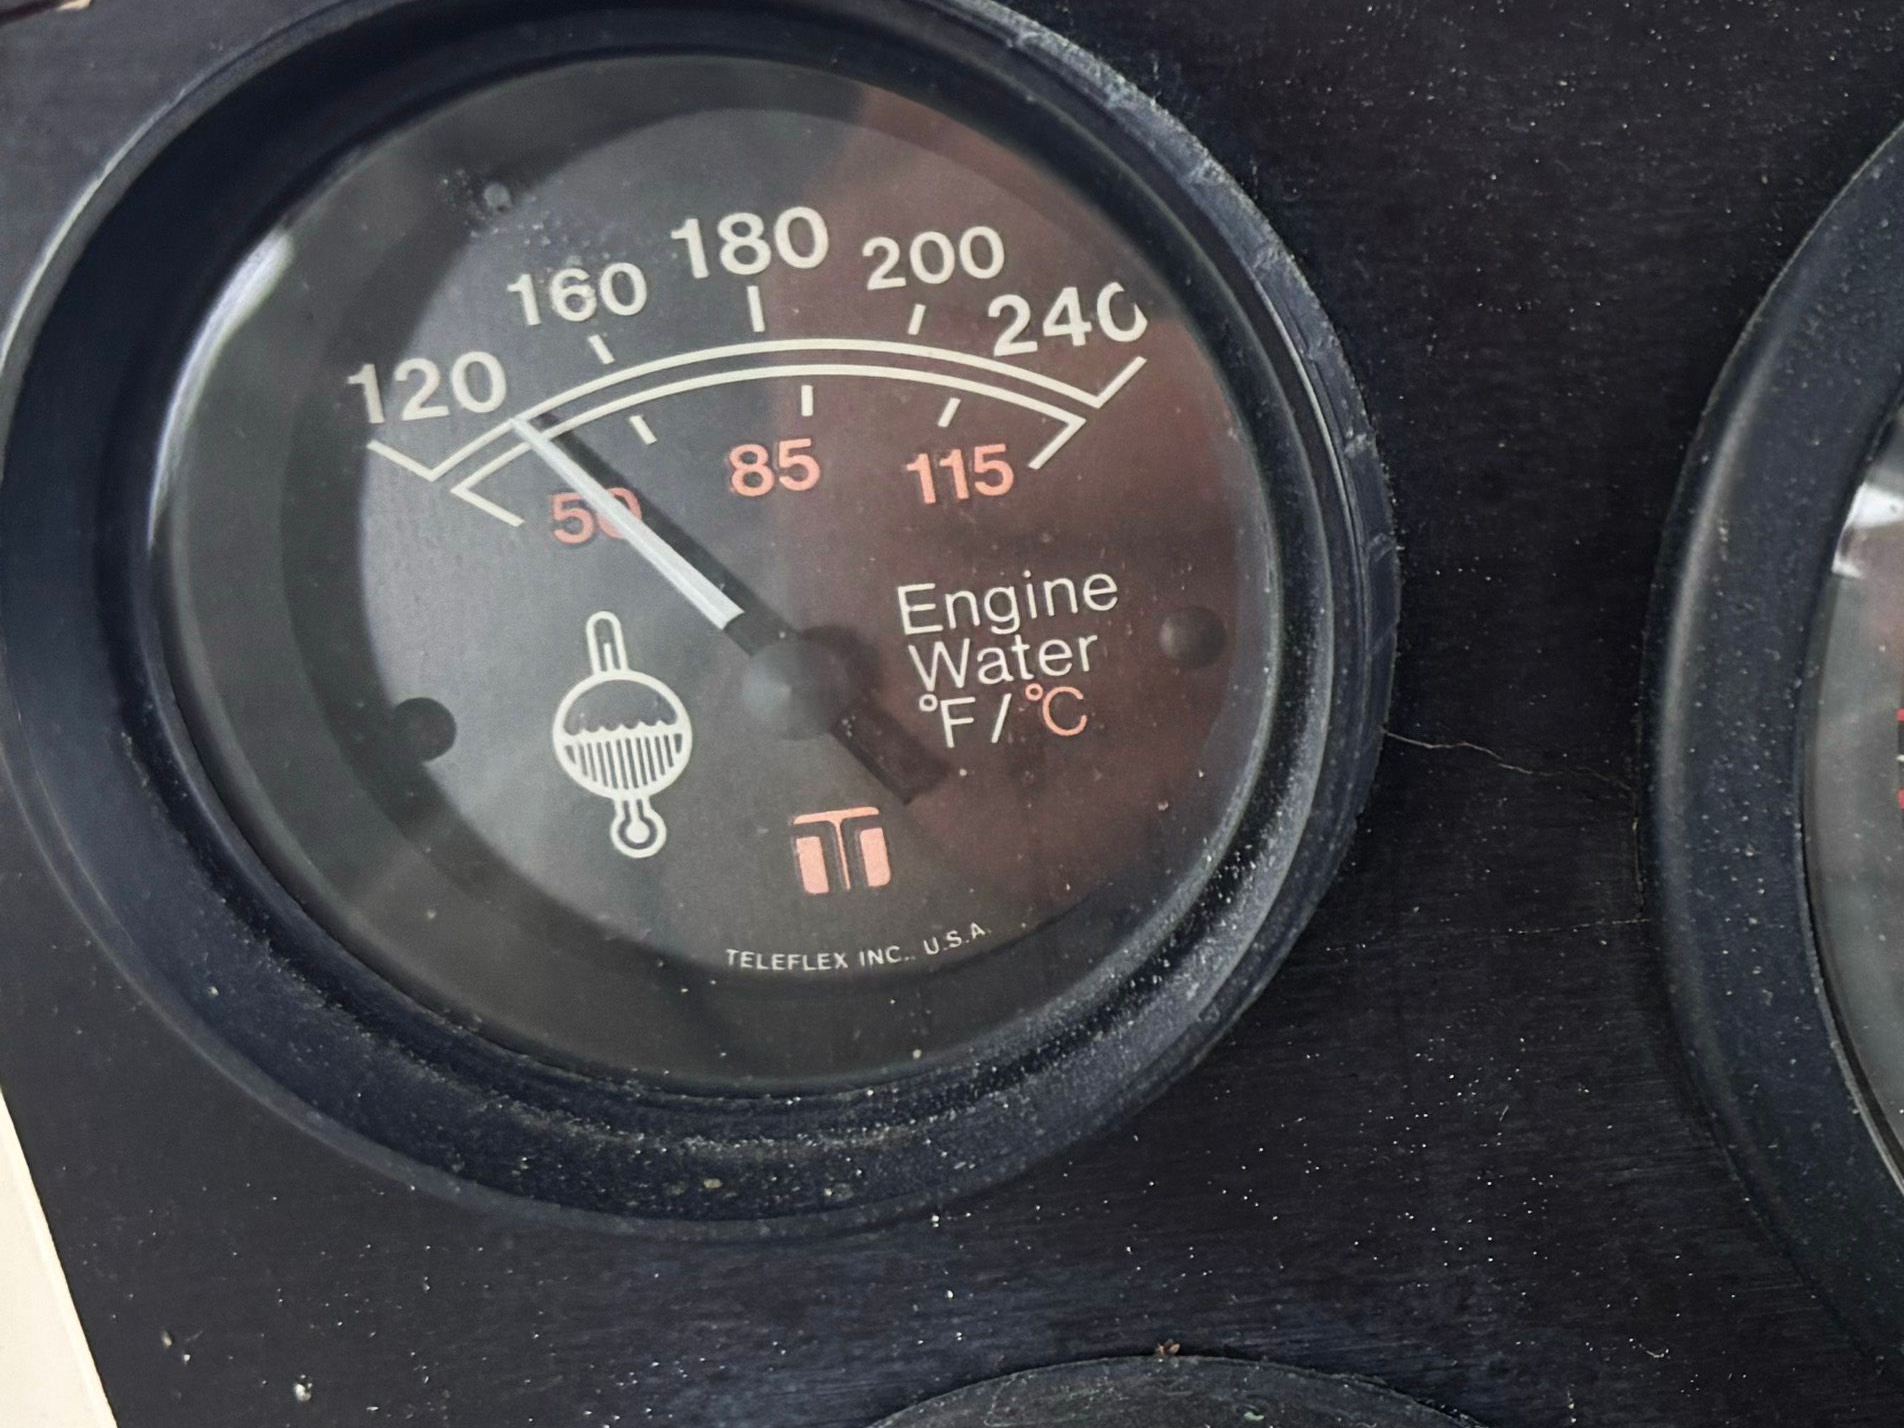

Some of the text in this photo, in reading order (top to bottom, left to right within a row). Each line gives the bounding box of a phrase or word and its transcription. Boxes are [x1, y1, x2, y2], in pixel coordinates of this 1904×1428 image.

[349, 207, 1147, 425] 120 160 180 200 240
[730, 439, 820, 496] 85
[906, 444, 1013, 503] 115
[898, 570, 1117, 634] Engine
[907, 633, 1098, 693] Water
[726, 949, 848, 971] TELEFLEX
